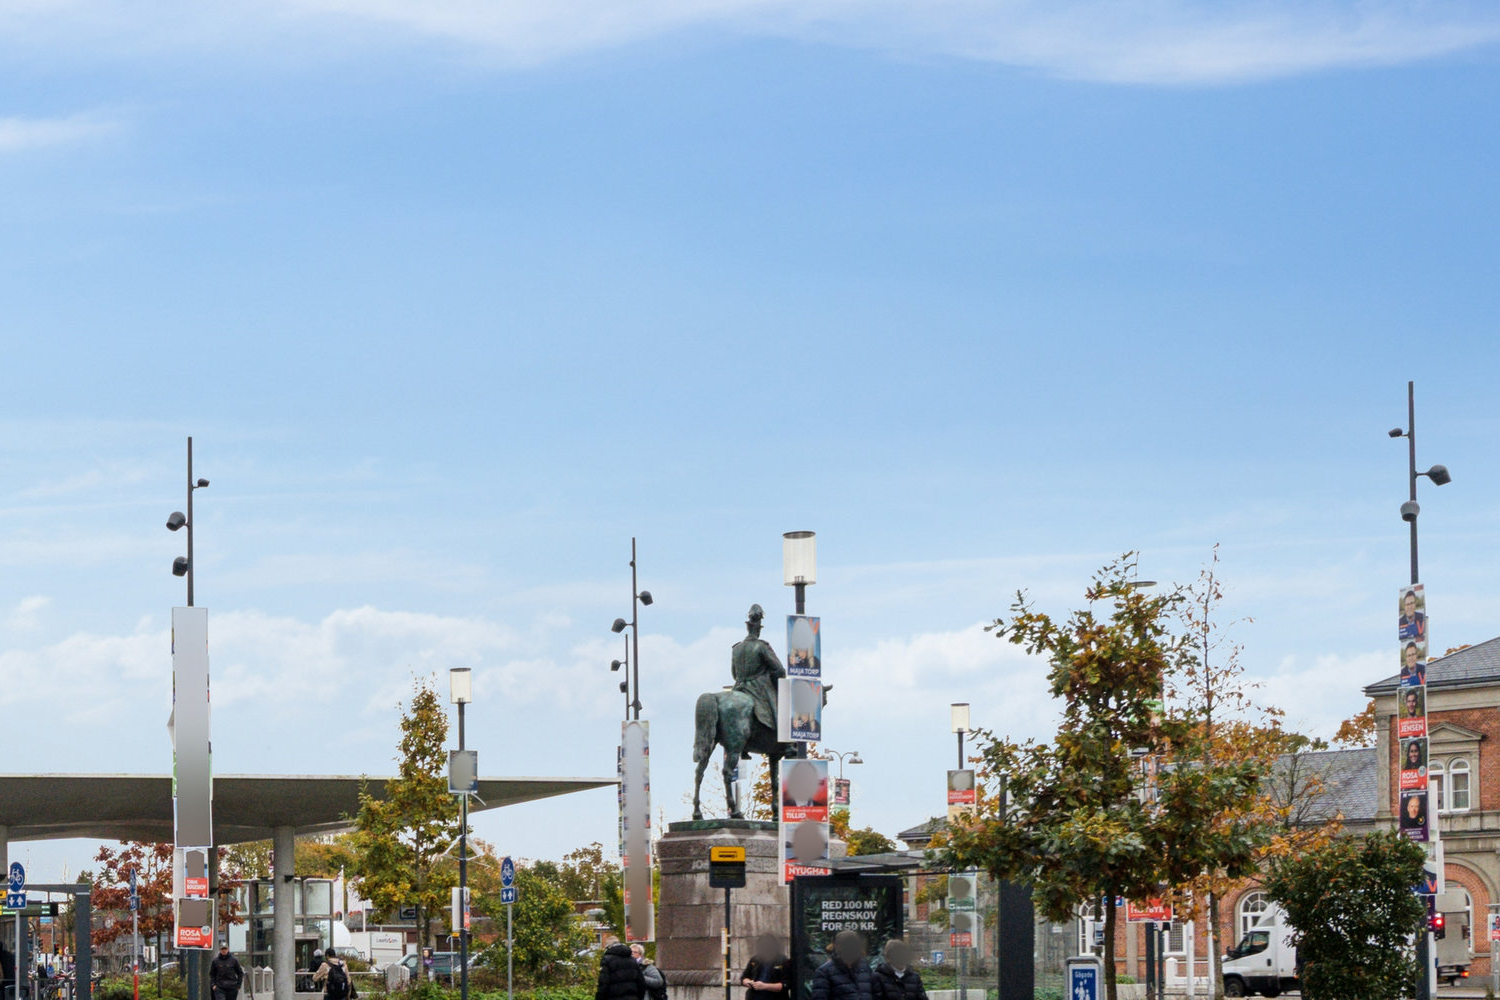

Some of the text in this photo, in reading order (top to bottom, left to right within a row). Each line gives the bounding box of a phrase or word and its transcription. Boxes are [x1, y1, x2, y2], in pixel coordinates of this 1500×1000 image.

[821, 900, 842, 910] RED
[843, 901, 862, 910] 100
[821, 911, 877, 920] REGNSKOV
[821, 922, 878, 931] FOR 50 KR.
[180, 929, 201, 937] ROSA
[1074, 971, 1093, 979] Gågade
